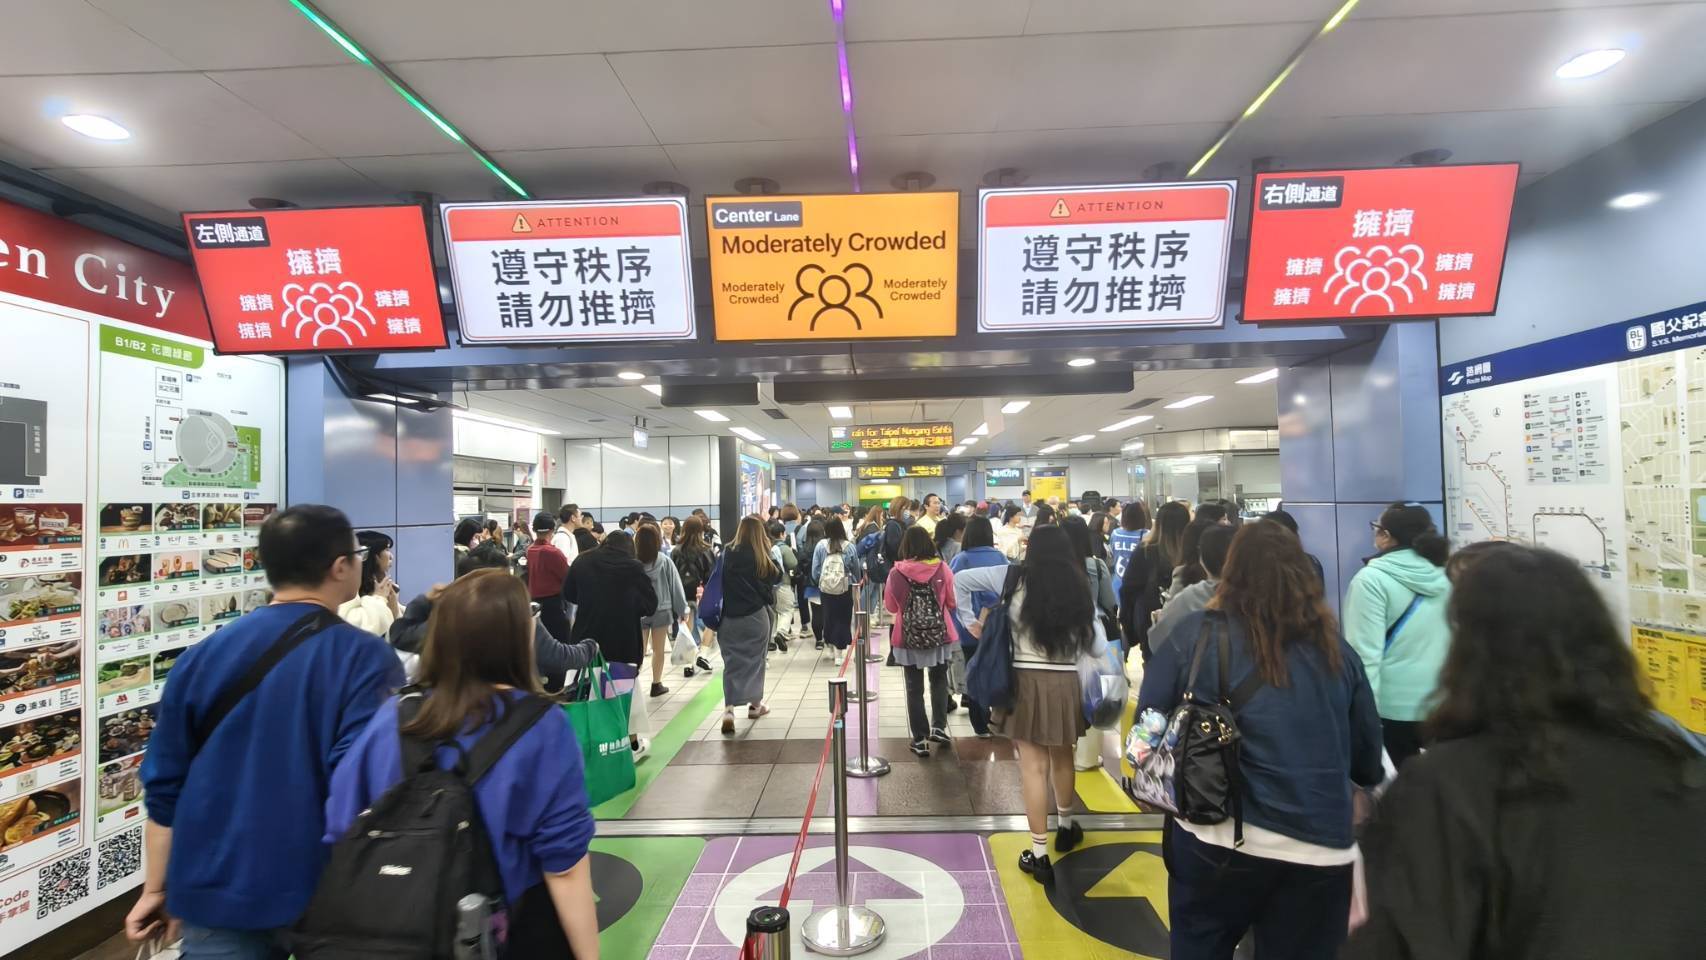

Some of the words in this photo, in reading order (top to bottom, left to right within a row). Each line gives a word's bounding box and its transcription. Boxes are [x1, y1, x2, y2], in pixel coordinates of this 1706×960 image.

[1263, 182, 1338, 205] 右側通道
[715, 207, 773, 224] Center
[774, 211, 801, 223] Lane
[1077, 201, 1165, 213] ATTENTION
[537, 215, 619, 229] ATTENTION
[1352, 208, 1415, 239] 擁擠
[195, 222, 265, 243] 左側通道
[722, 232, 843, 258] Moderately
[848, 231, 946, 252] Crowded
[1023, 230, 1190, 272] 遵守秩序
[286, 247, 342, 276] 擁擠
[491, 245, 651, 286] 遵守秩序
[1285, 257, 1324, 277] 擁擠
[1434, 252, 1474, 272] 擁擠
[74, 252, 176, 318] City
[722, 281, 785, 296] Moderately
[883, 278, 948, 291] Moderately
[1437, 281, 1477, 301] 擁擠
[239, 293, 274, 312] 擁擠
[374, 289, 410, 308] 擁擠
[729, 293, 780, 305] Crowded
[889, 289, 942, 302] Crowded
[1021, 274, 1187, 316] 請勿推擠
[1273, 287, 1311, 306] 擁擠
[497, 288, 656, 328] 請勿推擠
[238, 321, 272, 339] 擁擠
[386, 317, 421, 335] 擁擠
[1630, 330, 1642, 340] BL
[115, 336, 147, 352] B1/B2
[1631, 339, 1642, 348] 17
[0, 890, 30, 908] ode
